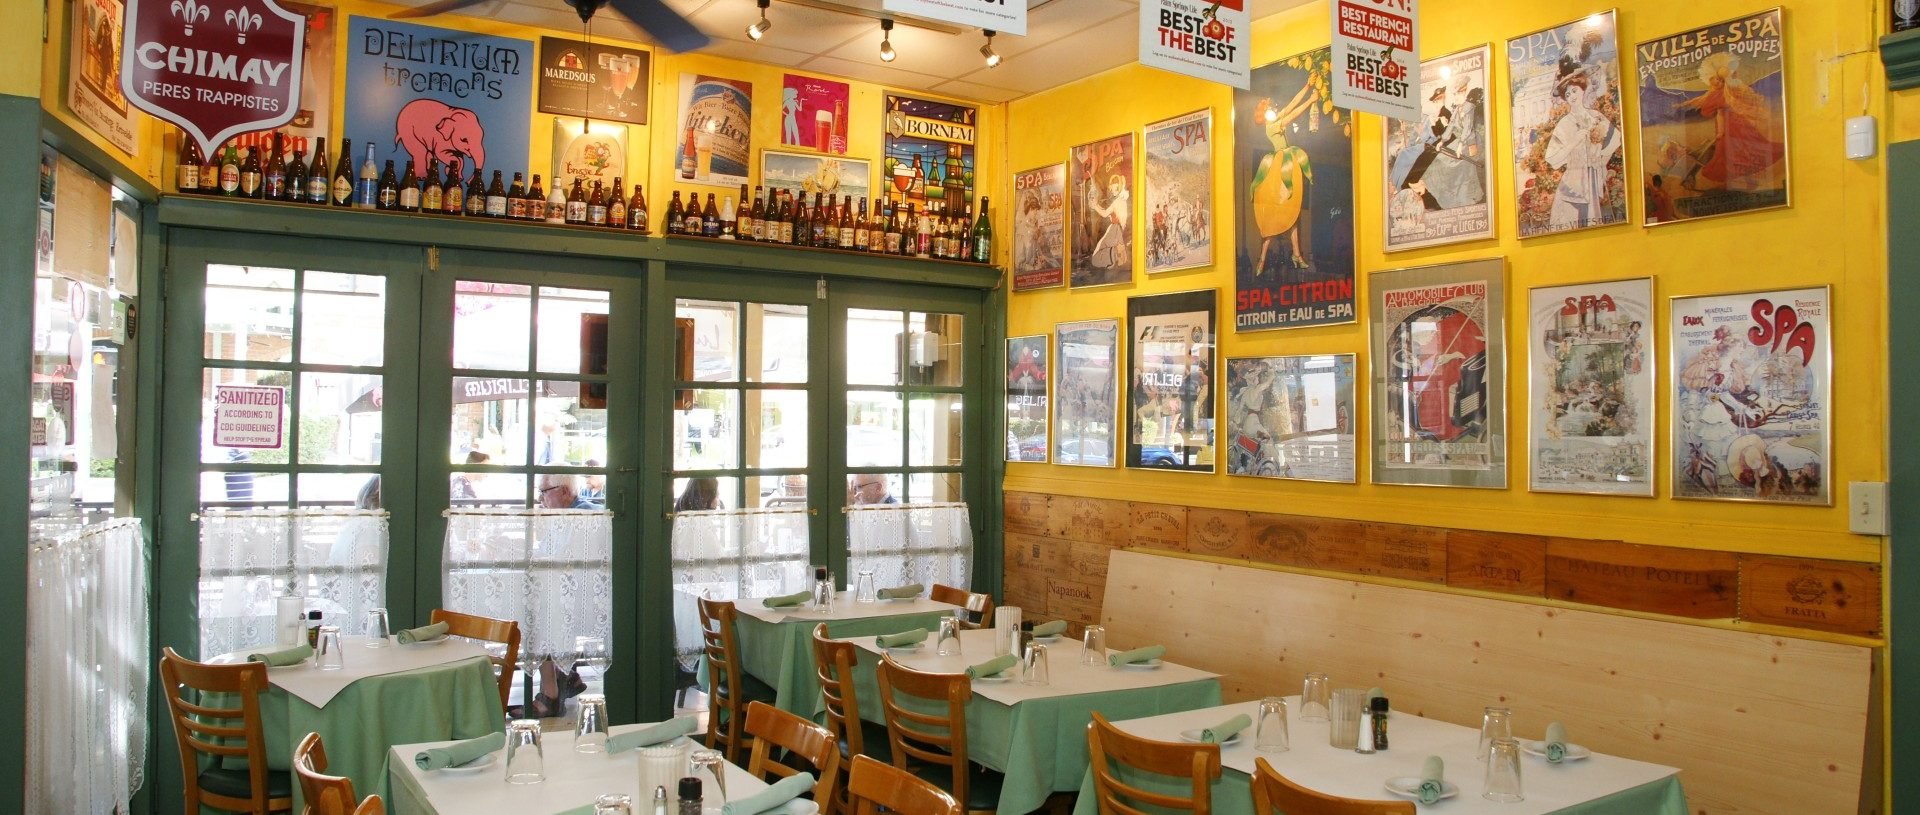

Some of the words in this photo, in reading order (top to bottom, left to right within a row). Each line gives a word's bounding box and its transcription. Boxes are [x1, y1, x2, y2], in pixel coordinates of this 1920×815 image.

[1341, 6, 1367, 23] BEST
[1369, 13, 1410, 35] FRENCH
[1343, 21, 1409, 47] RESTAURANT
[1509, 28, 1562, 63] SPA
[1640, 30, 1709, 62] VILLE
[1712, 35, 1725, 46] DE
[1726, 17, 1779, 42] SPA
[136, 41, 290, 87] CHIMAY
[364, 28, 520, 75] DELIRIUM
[1639, 44, 1712, 79] EXPOSITION
[545, 67, 596, 84] MAREDSOUS
[1453, 55, 1481, 75] SPORTS
[383, 62, 502, 100] tremens
[143, 80, 191, 99] PERES
[196, 88, 279, 112] TRAPPISTES
[905, 119, 972, 142] BORNEM
[1171, 121, 1207, 154] SPA
[1016, 172, 1043, 190] SPA
[1387, 286, 1453, 309] AUTOMOBILE
[1454, 284, 1484, 298] CLUB
[1560, 294, 1616, 317] SPA
[1237, 310, 1276, 327] CITRON
[1278, 313, 1288, 323] ET
[1289, 306, 1313, 322] EAU
[1315, 309, 1325, 319] DE
[1327, 303, 1354, 318] SPA
[1748, 299, 1815, 367] SPA
[220, 391, 278, 406] SANITIZED
[224, 410, 263, 419] ACCORDING
[265, 411, 273, 419] TO
[220, 423, 235, 431] CDC
[236, 423, 276, 433] GUIDELINES
[1049, 580, 1092, 601] Napanook
[1784, 606, 1826, 619] FRATTA
